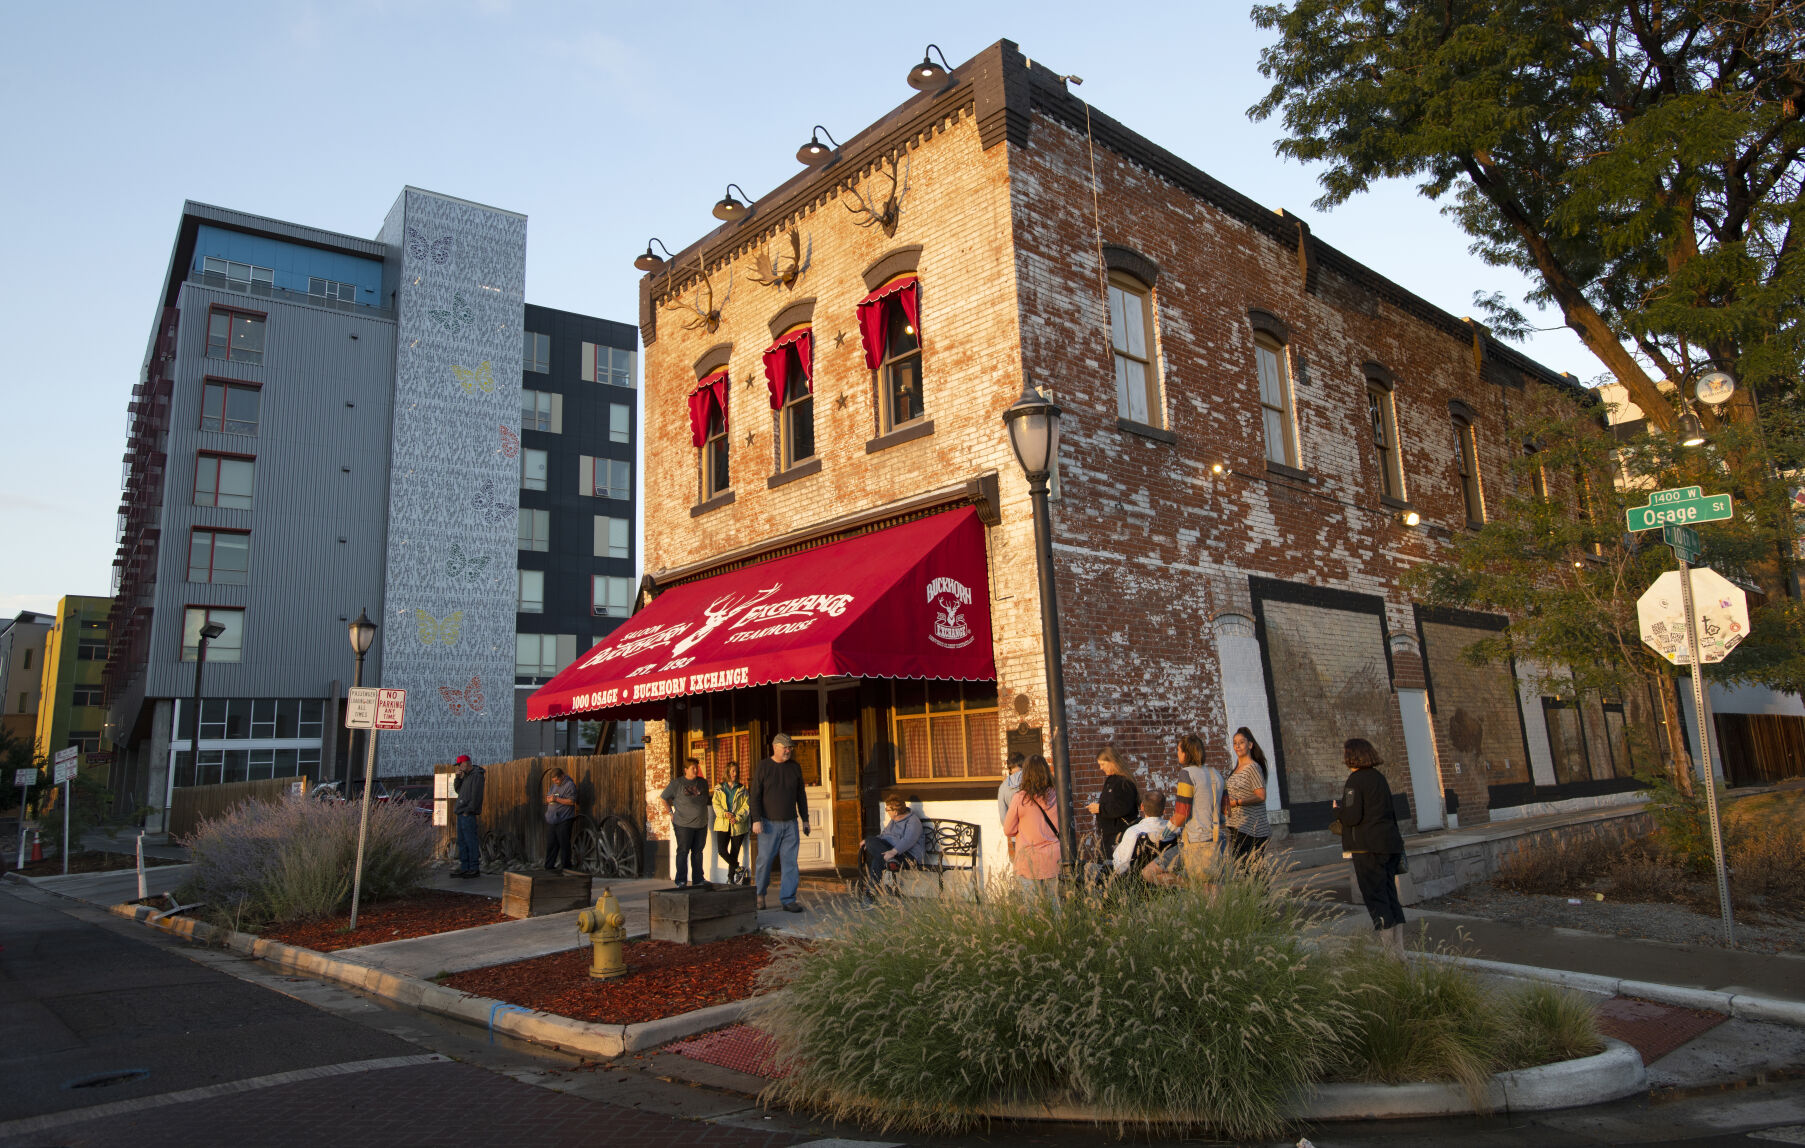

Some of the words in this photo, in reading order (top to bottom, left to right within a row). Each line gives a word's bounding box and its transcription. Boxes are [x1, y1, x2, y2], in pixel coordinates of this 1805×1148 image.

[1654, 491, 1680, 503] 1400
[1687, 489, 1696, 498] W
[1643, 506, 1697, 525] Osage
[1712, 502, 1725, 511] St
[926, 576, 973, 605] BUCKHORN
[577, 622, 694, 670] BUCKHORN
[728, 594, 855, 631] EXCHANGE
[724, 618, 818, 644] STEAKHOUSE
[936, 624, 966, 638] EXCHANGE
[572, 694, 590, 710] 1000
[591, 688, 619, 707] OSAGE
[633, 677, 687, 700] BUCKHORN
[689, 667, 749, 691] EXCHANGE
[380, 700, 403, 708] PARKING
